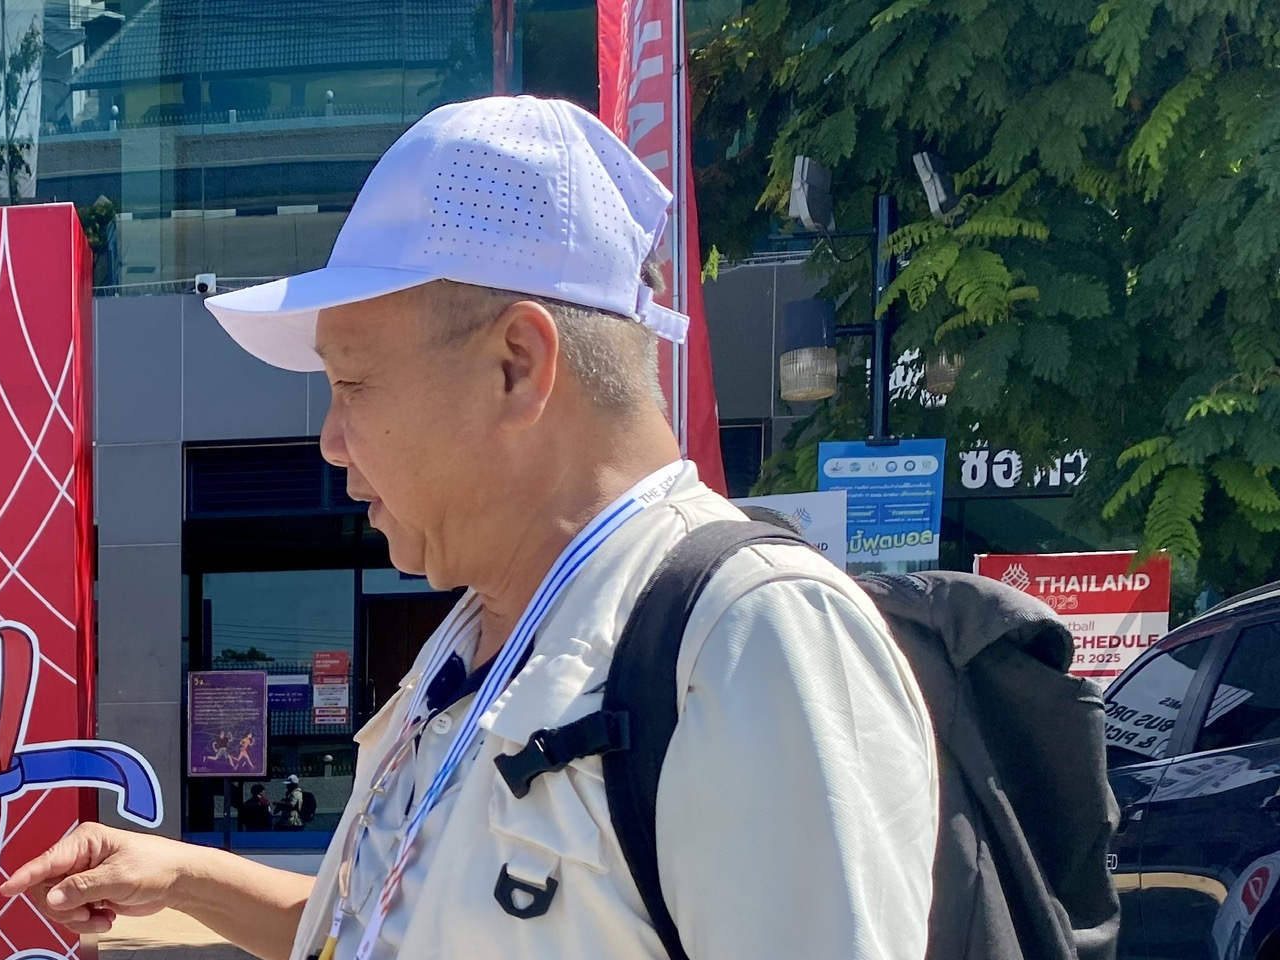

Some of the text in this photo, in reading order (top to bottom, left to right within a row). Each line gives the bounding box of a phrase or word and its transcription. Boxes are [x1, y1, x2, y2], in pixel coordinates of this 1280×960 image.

[639, 487, 661, 503] THE
[849, 529, 934, 556] บี้ฟุตบอล
[1035, 573, 1151, 594] THAILAND
[1065, 621, 1095, 632] tball
[1073, 634, 1160, 650] CHEDULE
[1089, 653, 1121, 664] 2025
